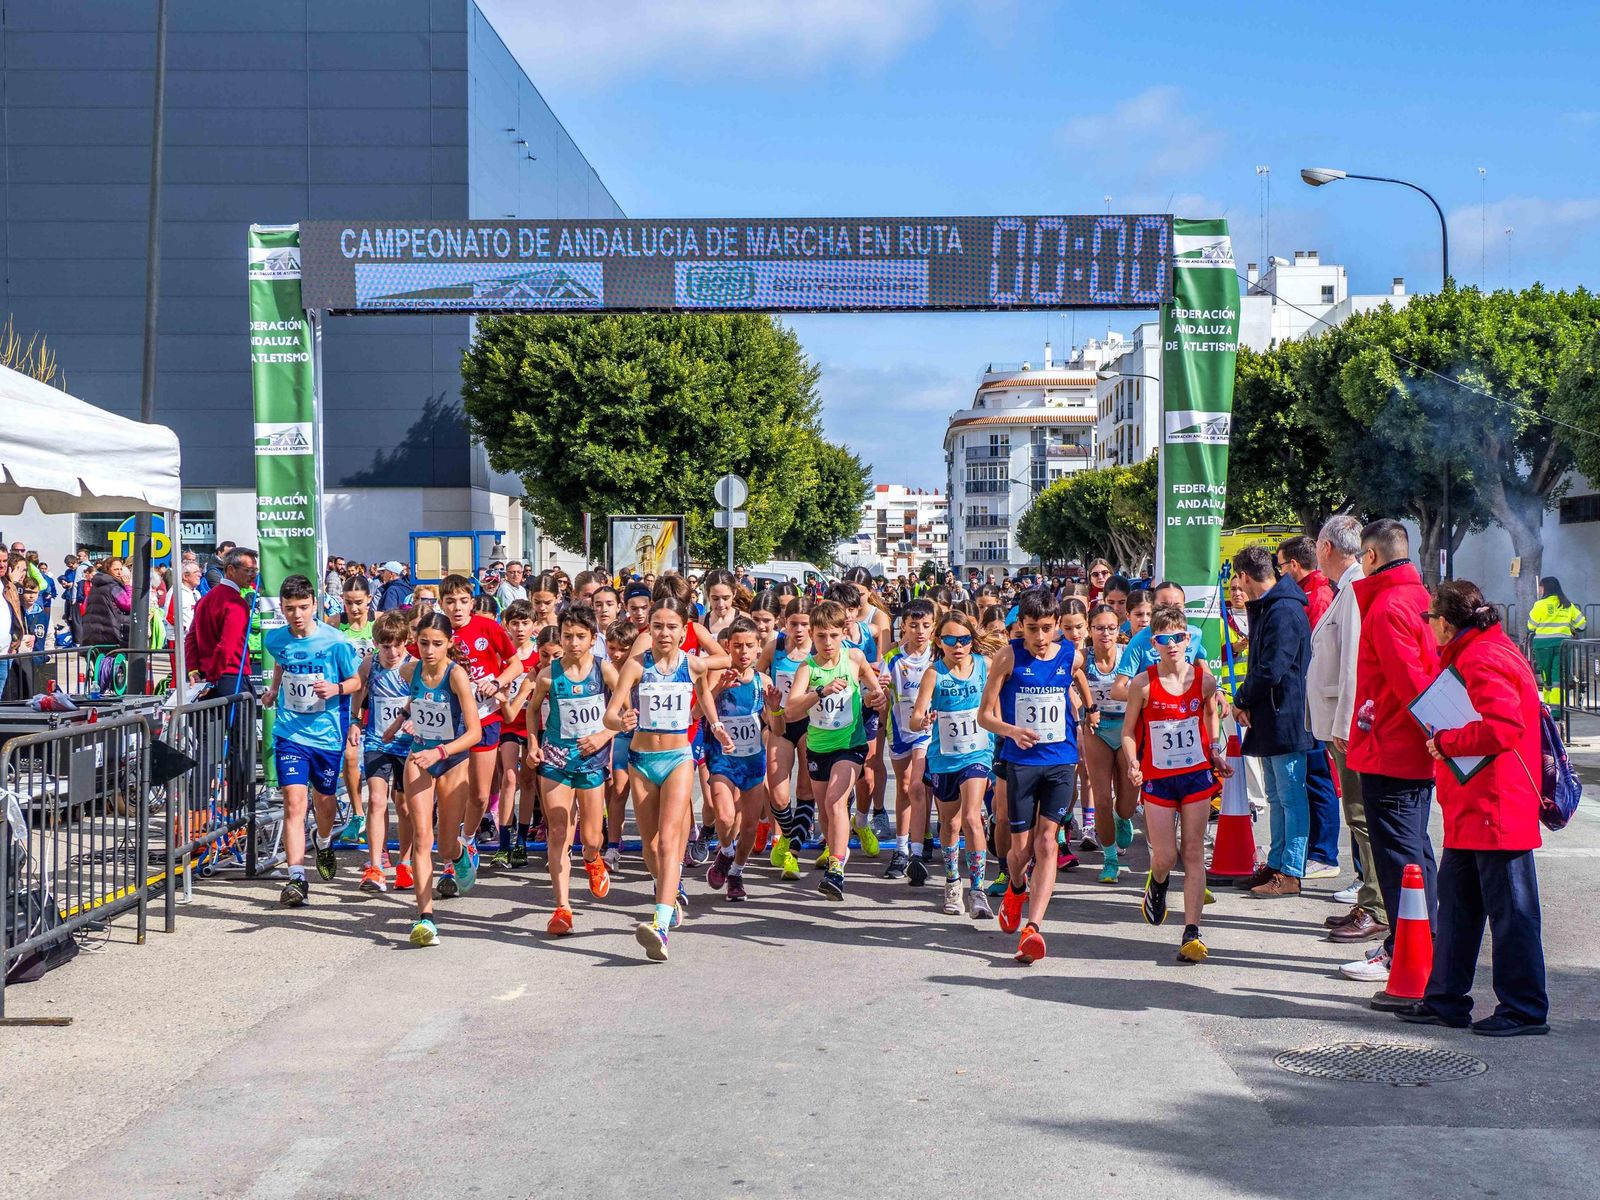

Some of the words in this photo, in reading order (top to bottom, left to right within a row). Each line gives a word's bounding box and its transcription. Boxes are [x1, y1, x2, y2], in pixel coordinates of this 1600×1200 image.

[341, 228, 510, 259] CAMPEONATO
[518, 228, 551, 257] DE
[557, 227, 699, 257] ANDALUCIA
[706, 226, 738, 256] DE
[746, 225, 853, 257] MARCHA
[860, 224, 891, 256] EN
[900, 224, 964, 255] RUTA
[361, 299, 432, 307] FEDERACIÓN
[1171, 306, 1235, 319] FEDERACIÓN
[1174, 325, 1232, 335] ANDALUZA
[1166, 341, 1178, 350] DE
[1183, 342, 1235, 352] ATLETISMO
[1168, 517, 1181, 525] DE
[940, 685, 977, 698] nerja
[649, 694, 683, 711] 341
[816, 697, 844, 713] 304
[417, 709, 446, 727] 329
[569, 705, 600, 725] 300
[1025, 706, 1059, 723] 310
[730, 724, 756, 740] 303
[949, 719, 978, 738] 311
[1162, 729, 1194, 750] 313
